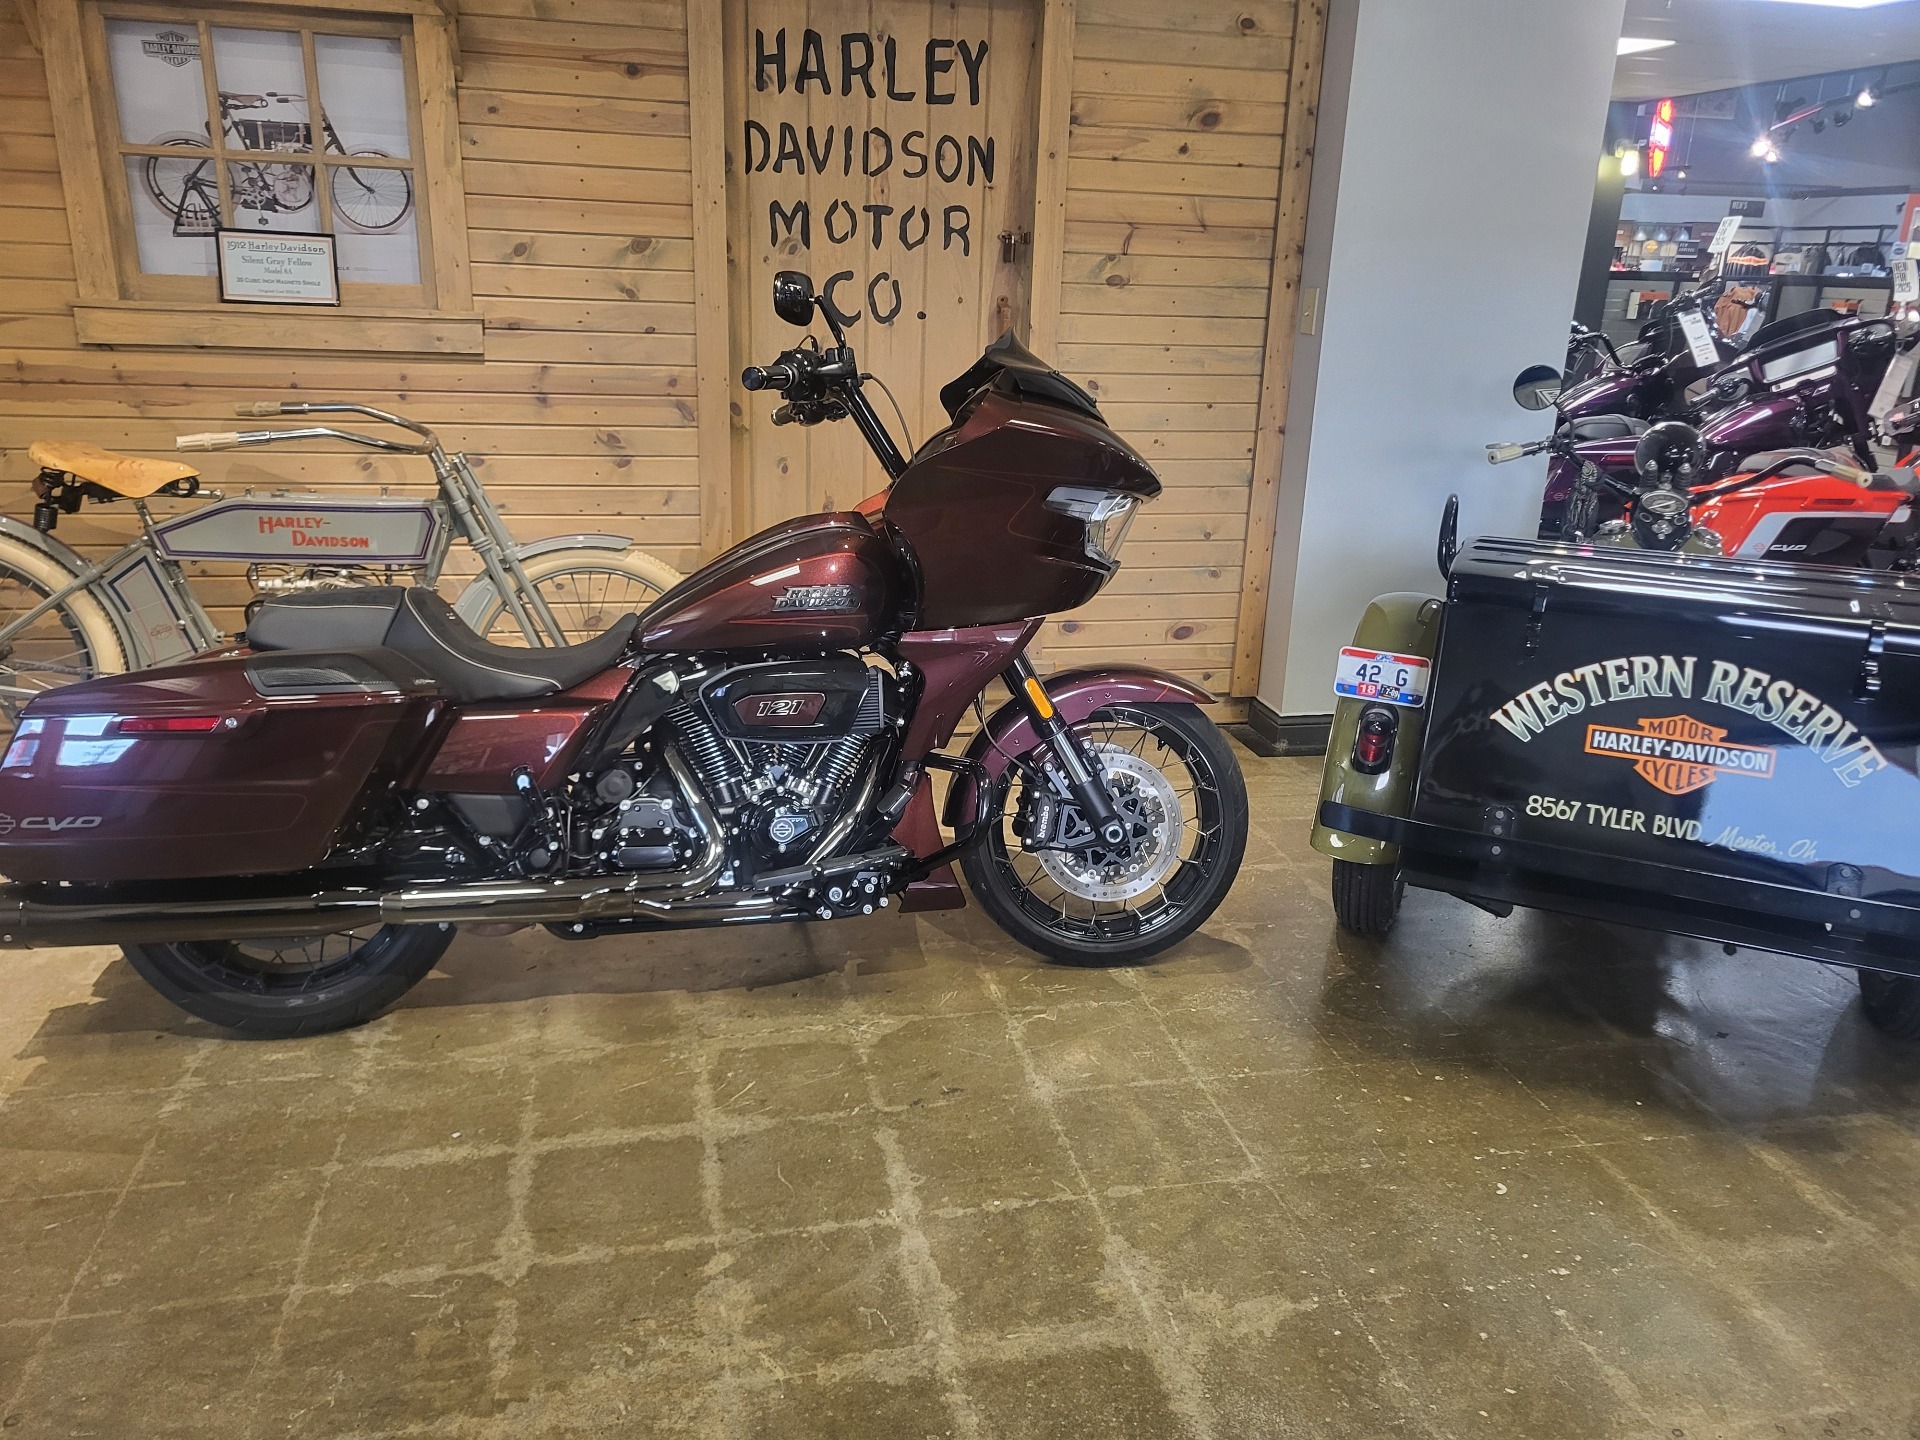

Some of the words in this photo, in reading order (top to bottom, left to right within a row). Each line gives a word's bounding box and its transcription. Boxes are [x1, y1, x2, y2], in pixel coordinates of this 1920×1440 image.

[755, 27, 988, 105] HARLEY
[744, 120, 994, 186] DAVIDSON
[769, 199, 970, 256] MOTOR
[227, 241, 246, 250] 1912
[248, 241, 279, 252] Harley
[280, 243, 326, 255] Davidson
[241, 255, 264, 264] Silent
[266, 257, 285, 266] Gray
[287, 258, 312, 266] Fellow
[823, 270, 926, 327] CO.
[259, 516, 331, 534] HARLEY-
[292, 530, 369, 548] DAVIDSON
[1769, 544, 1807, 552] CVO
[1356, 663, 1381, 683] 42
[1395, 668, 1409, 687] G
[1360, 684, 1376, 694] 18
[756, 700, 805, 716] 121
[1489, 655, 1697, 743] WESTERN
[1702, 659, 1889, 790] RESERVE
[1648, 717, 1713, 742] MOTOR
[1592, 730, 1769, 771] HARLEY-DAVIDSON
[1642, 759, 1710, 791] CYCLES
[20, 816, 102, 831] CVO
[1037, 805, 1050, 839] brembo
[1526, 795, 1581, 821] 8567
[1586, 803, 1647, 833] TYLER
